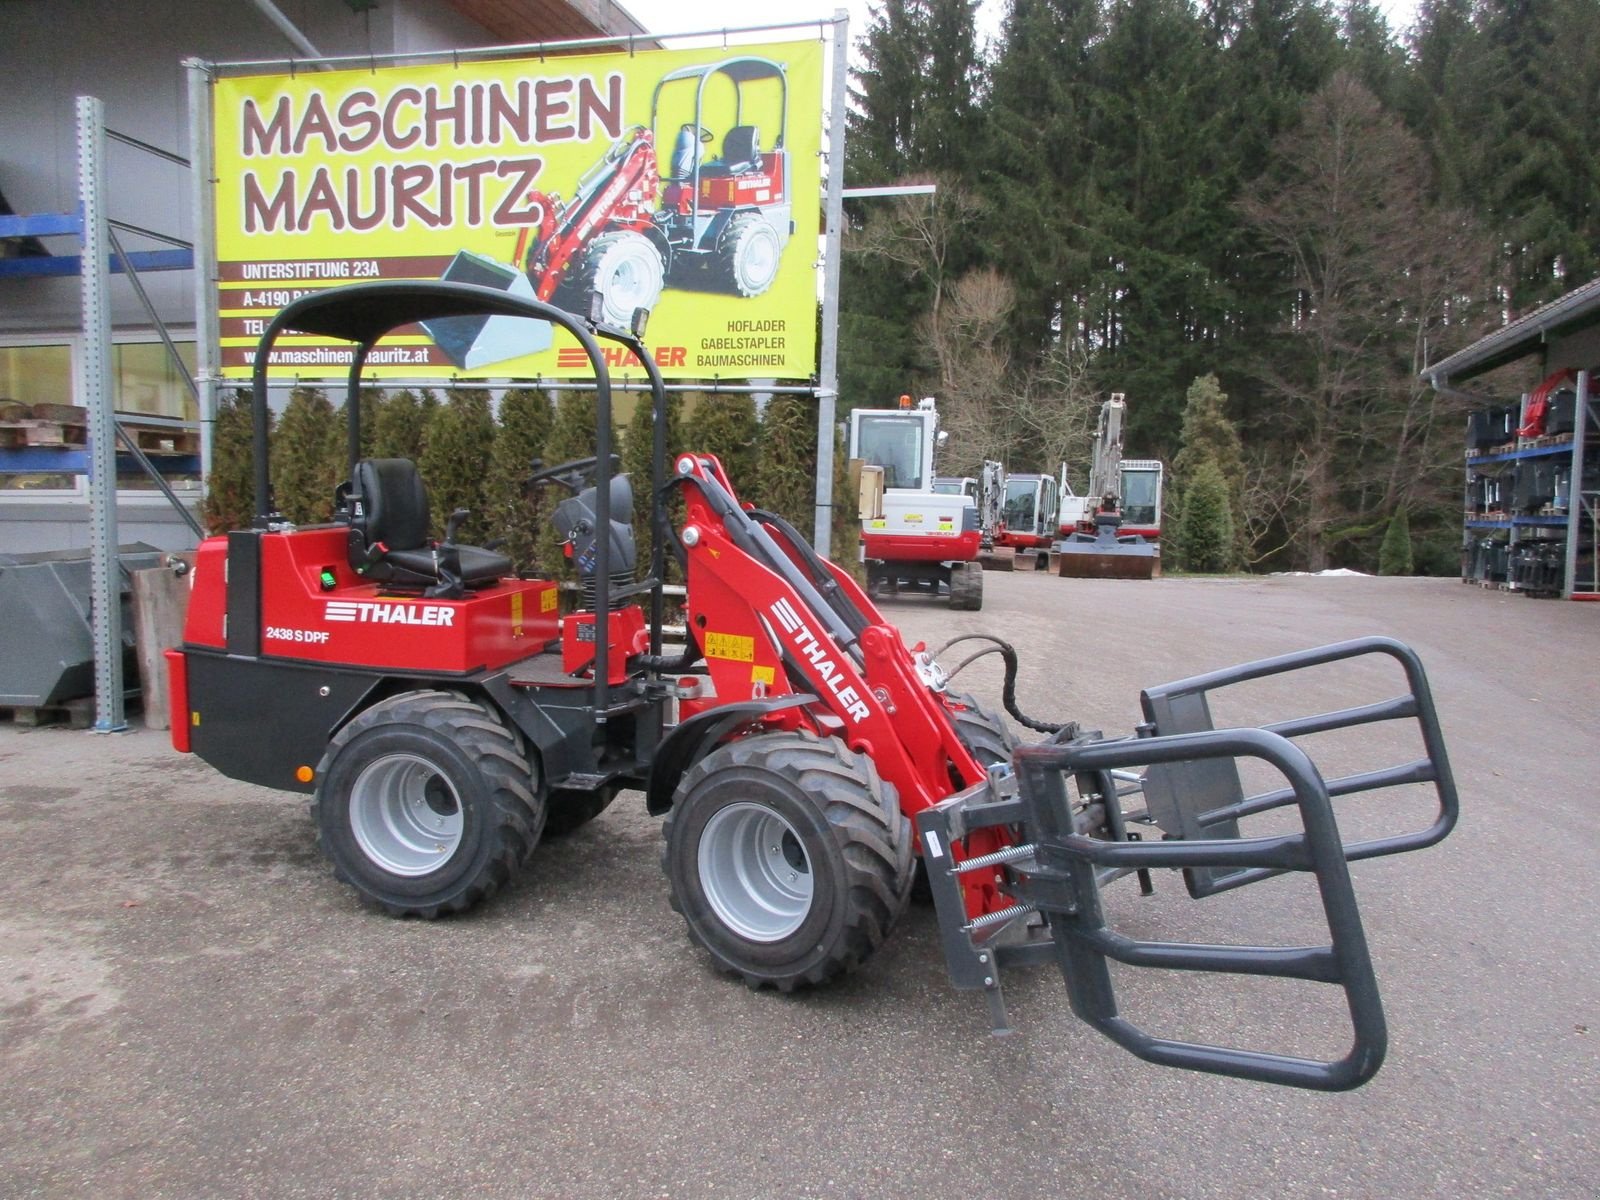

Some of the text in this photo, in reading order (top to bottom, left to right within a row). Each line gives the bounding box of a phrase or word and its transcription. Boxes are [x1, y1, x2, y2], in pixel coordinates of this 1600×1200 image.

[243, 75, 621, 156] MASCHINEN
[244, 159, 542, 232] MAURITZ
[242, 260, 380, 279] UNTERSTIFTUNG 23A
[243, 291, 290, 306] A-4190
[727, 320, 786, 332] HOFLADER
[701, 337, 785, 350] GABELSTAPLER
[599, 347, 687, 367] HAER
[696, 354, 785, 367] BAUMASCHINEN
[356, 603, 455, 626] THALER
[266, 627, 330, 644] 2438 S DPF
[794, 624, 870, 724] THALER
